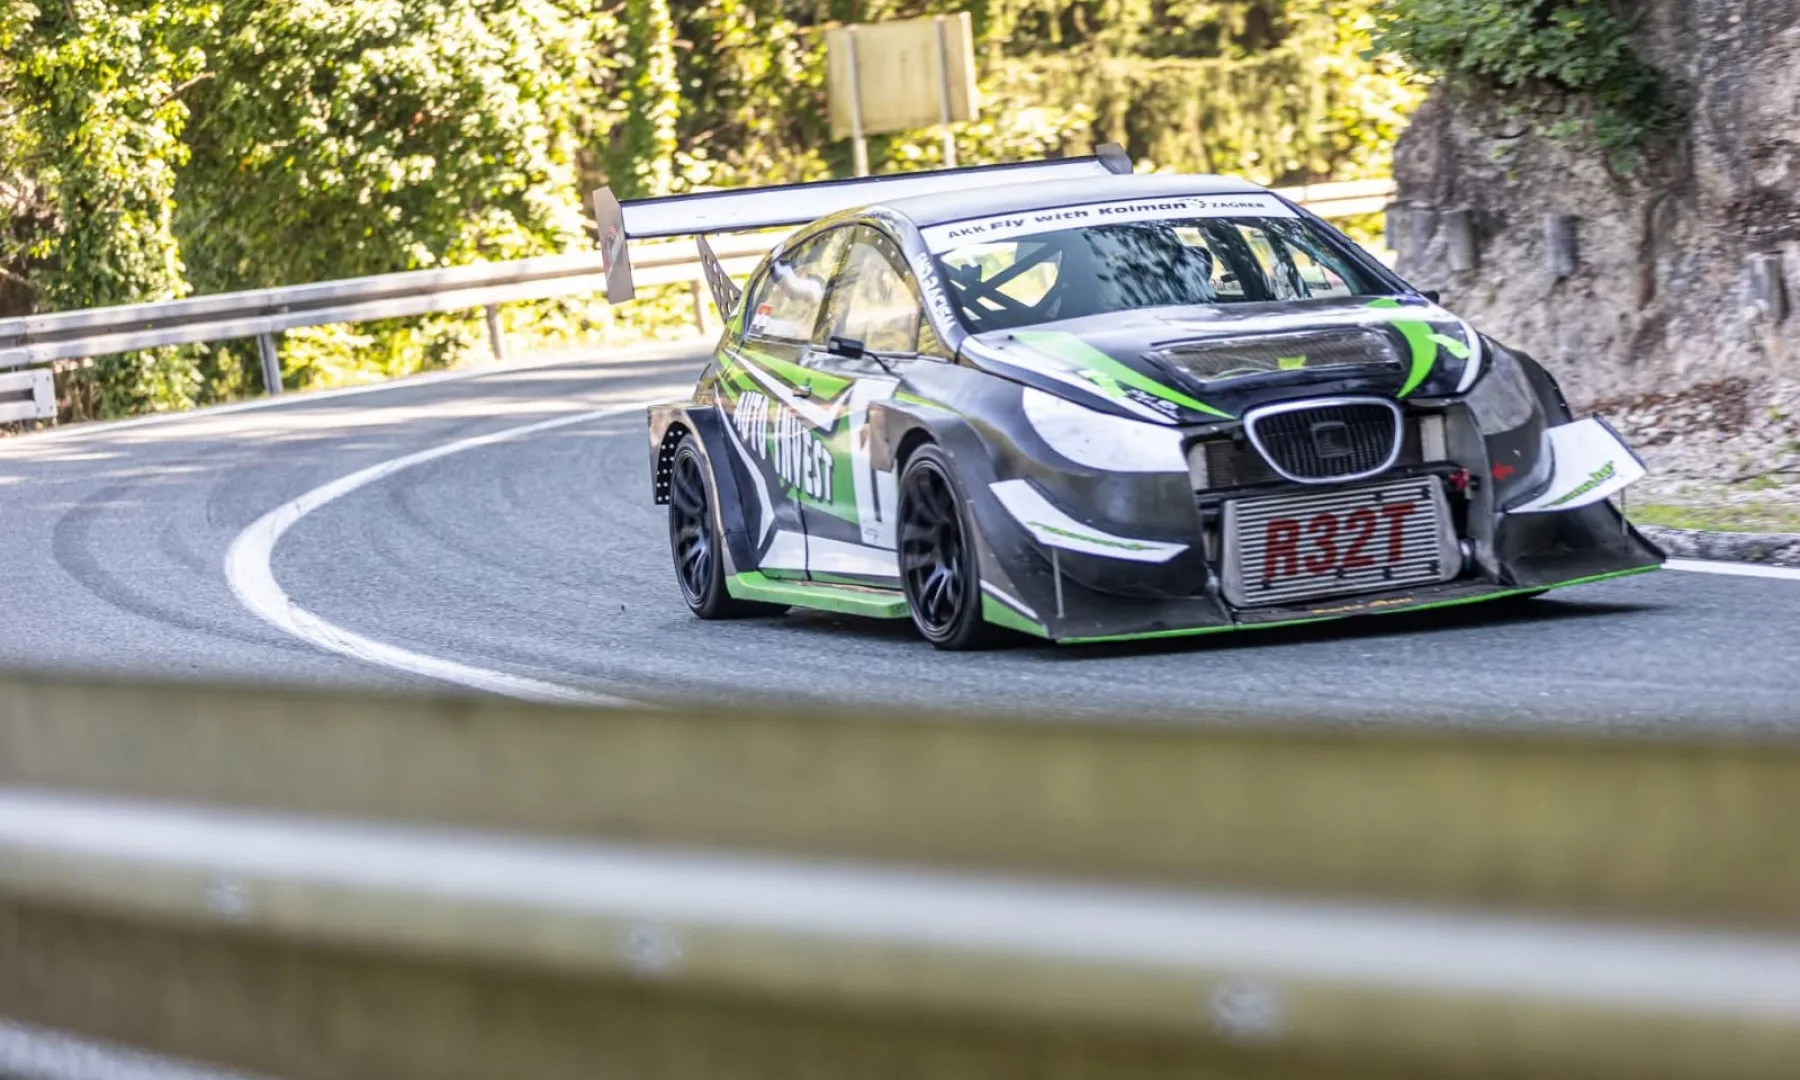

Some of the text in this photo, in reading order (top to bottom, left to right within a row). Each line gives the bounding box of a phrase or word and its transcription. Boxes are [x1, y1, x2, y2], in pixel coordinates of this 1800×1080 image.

[948, 225, 987, 238] AKK
[990, 217, 1025, 231] Fly
[1034, 209, 1089, 223] with
[774, 401, 833, 502] INVEST
[1263, 501, 1415, 580] R32T
